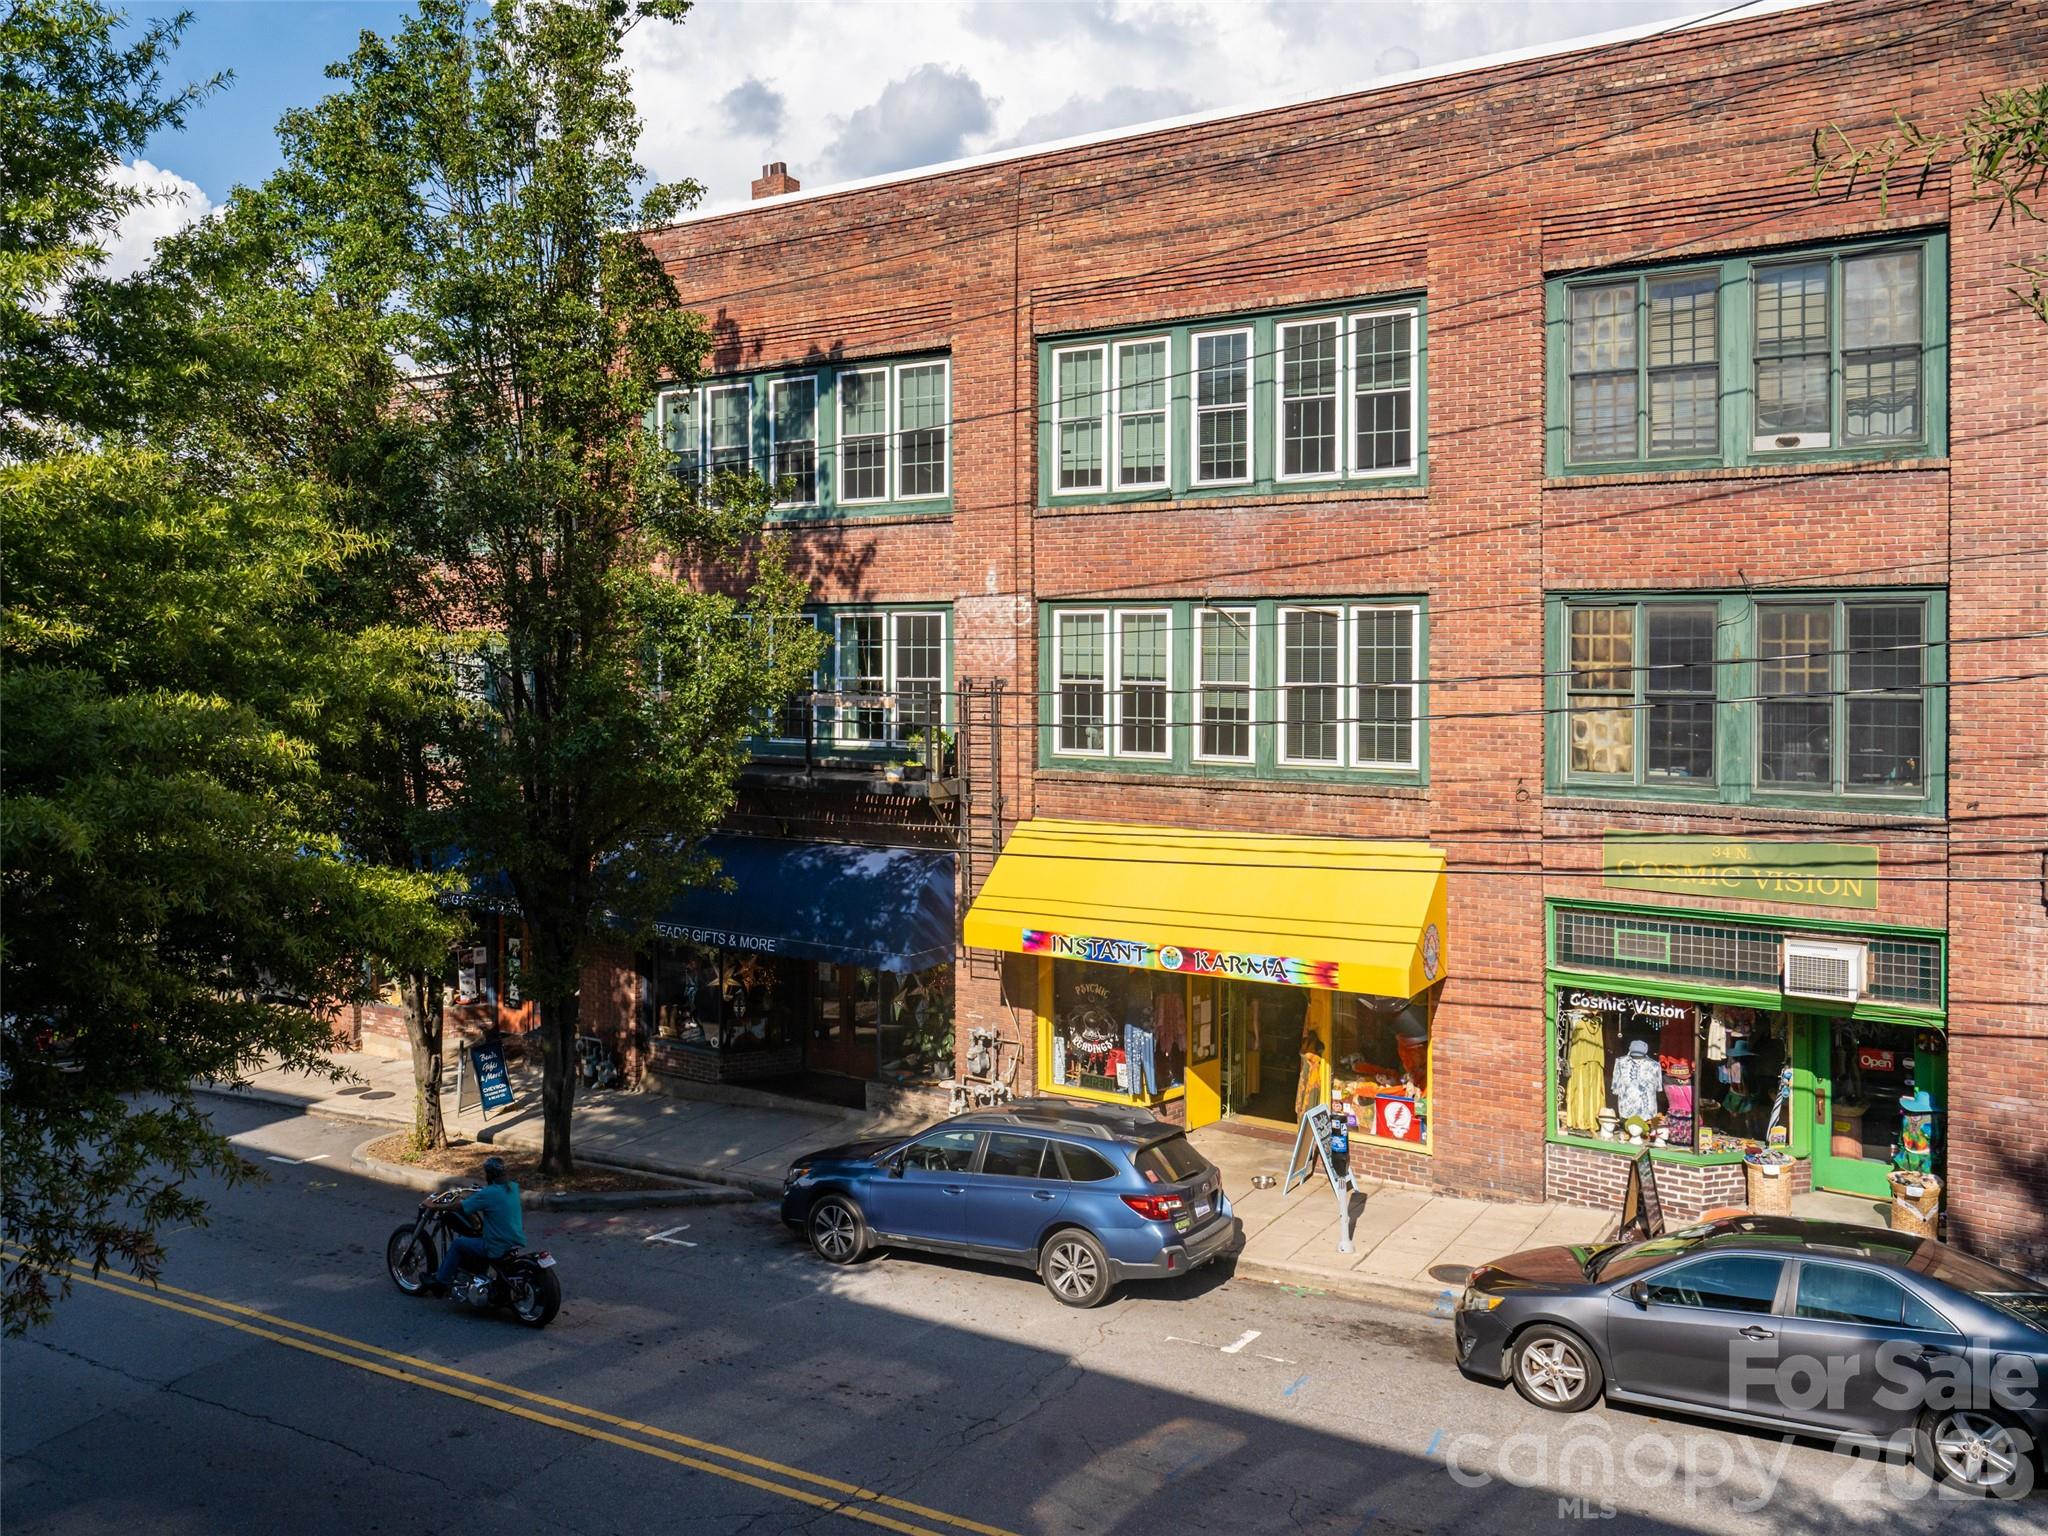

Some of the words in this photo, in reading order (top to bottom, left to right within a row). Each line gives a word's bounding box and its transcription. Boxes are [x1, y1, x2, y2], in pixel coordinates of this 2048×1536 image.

[1711, 846, 1730, 858] 34
[1736, 847, 1751, 860] N.
[1617, 858, 1740, 888] COSMIC
[1752, 869, 1862, 897] VISION
[692, 929, 726, 945] GIFTS
[729, 934, 736, 947] &
[739, 937, 776, 952] MORE
[1051, 935, 1149, 963] INSTANT
[1194, 951, 1288, 979] KARMA
[1074, 983, 1110, 999] PSYCHIC
[1569, 992, 1627, 1012] Cosmic
[1634, 1000, 1685, 1019] Vision
[1071, 1035, 1114, 1053] READINGS
[1861, 1055, 1892, 1068] Open
